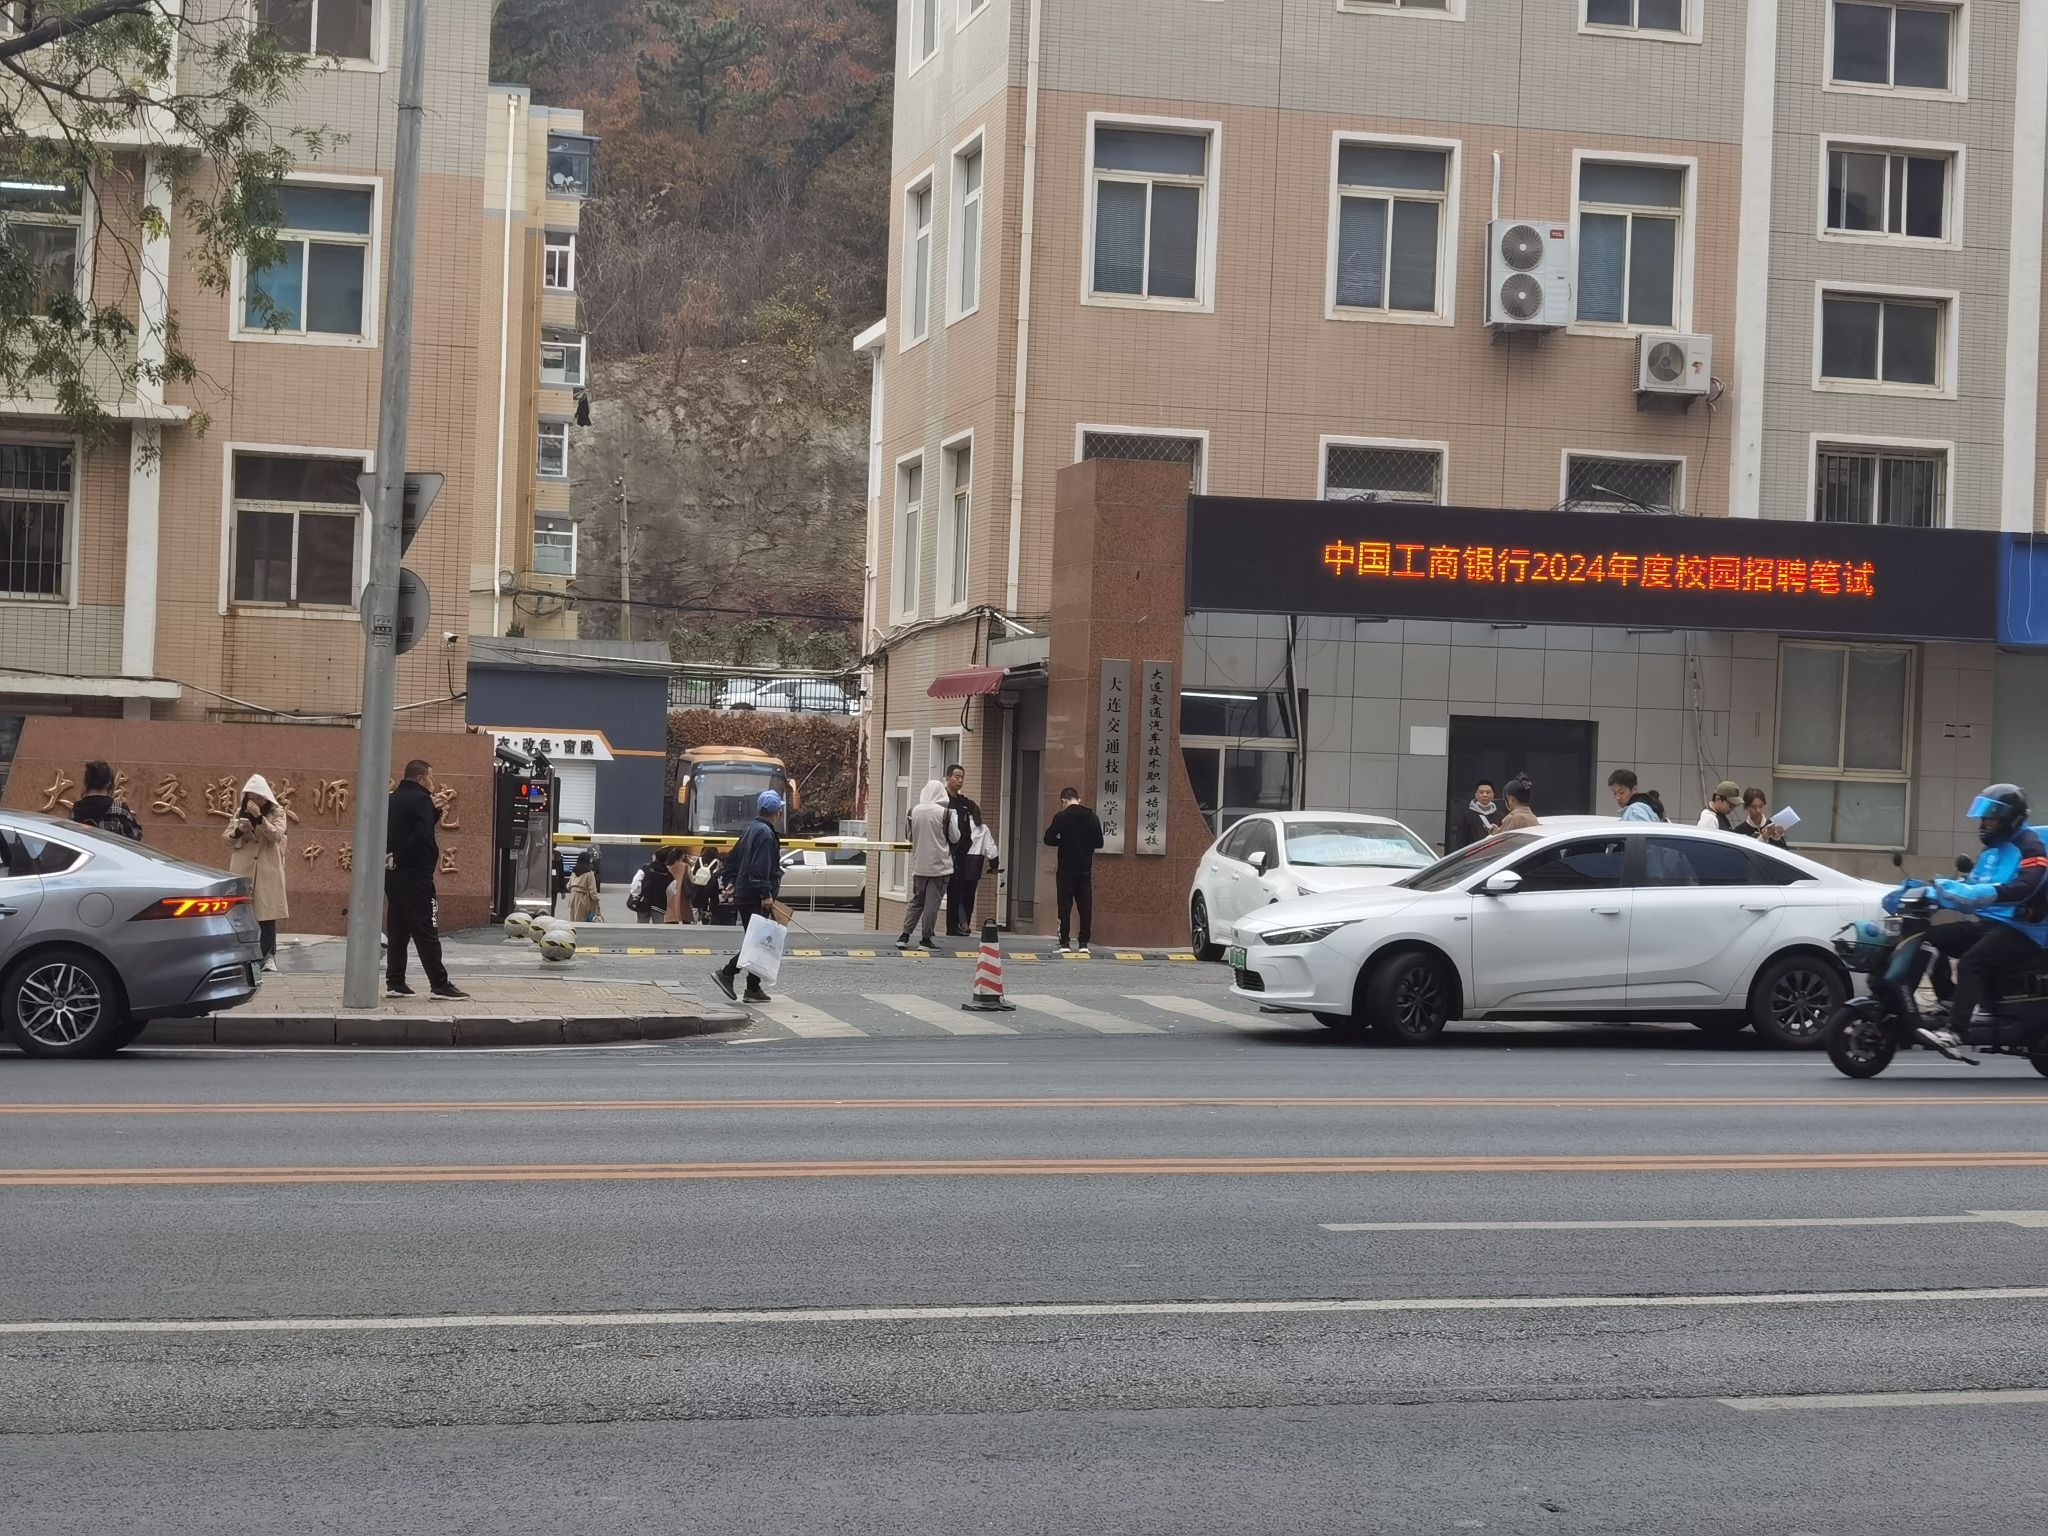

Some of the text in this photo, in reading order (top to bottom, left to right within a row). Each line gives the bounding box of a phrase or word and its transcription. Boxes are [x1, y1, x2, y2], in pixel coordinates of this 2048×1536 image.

[1324, 539, 1876, 597] 中国工商银行2024年度校园招聘笔试
[1102, 676, 1122, 837] 大连交通技师学院
[1144, 668, 1164, 847] 大连交通汽车技术职业培训学校
